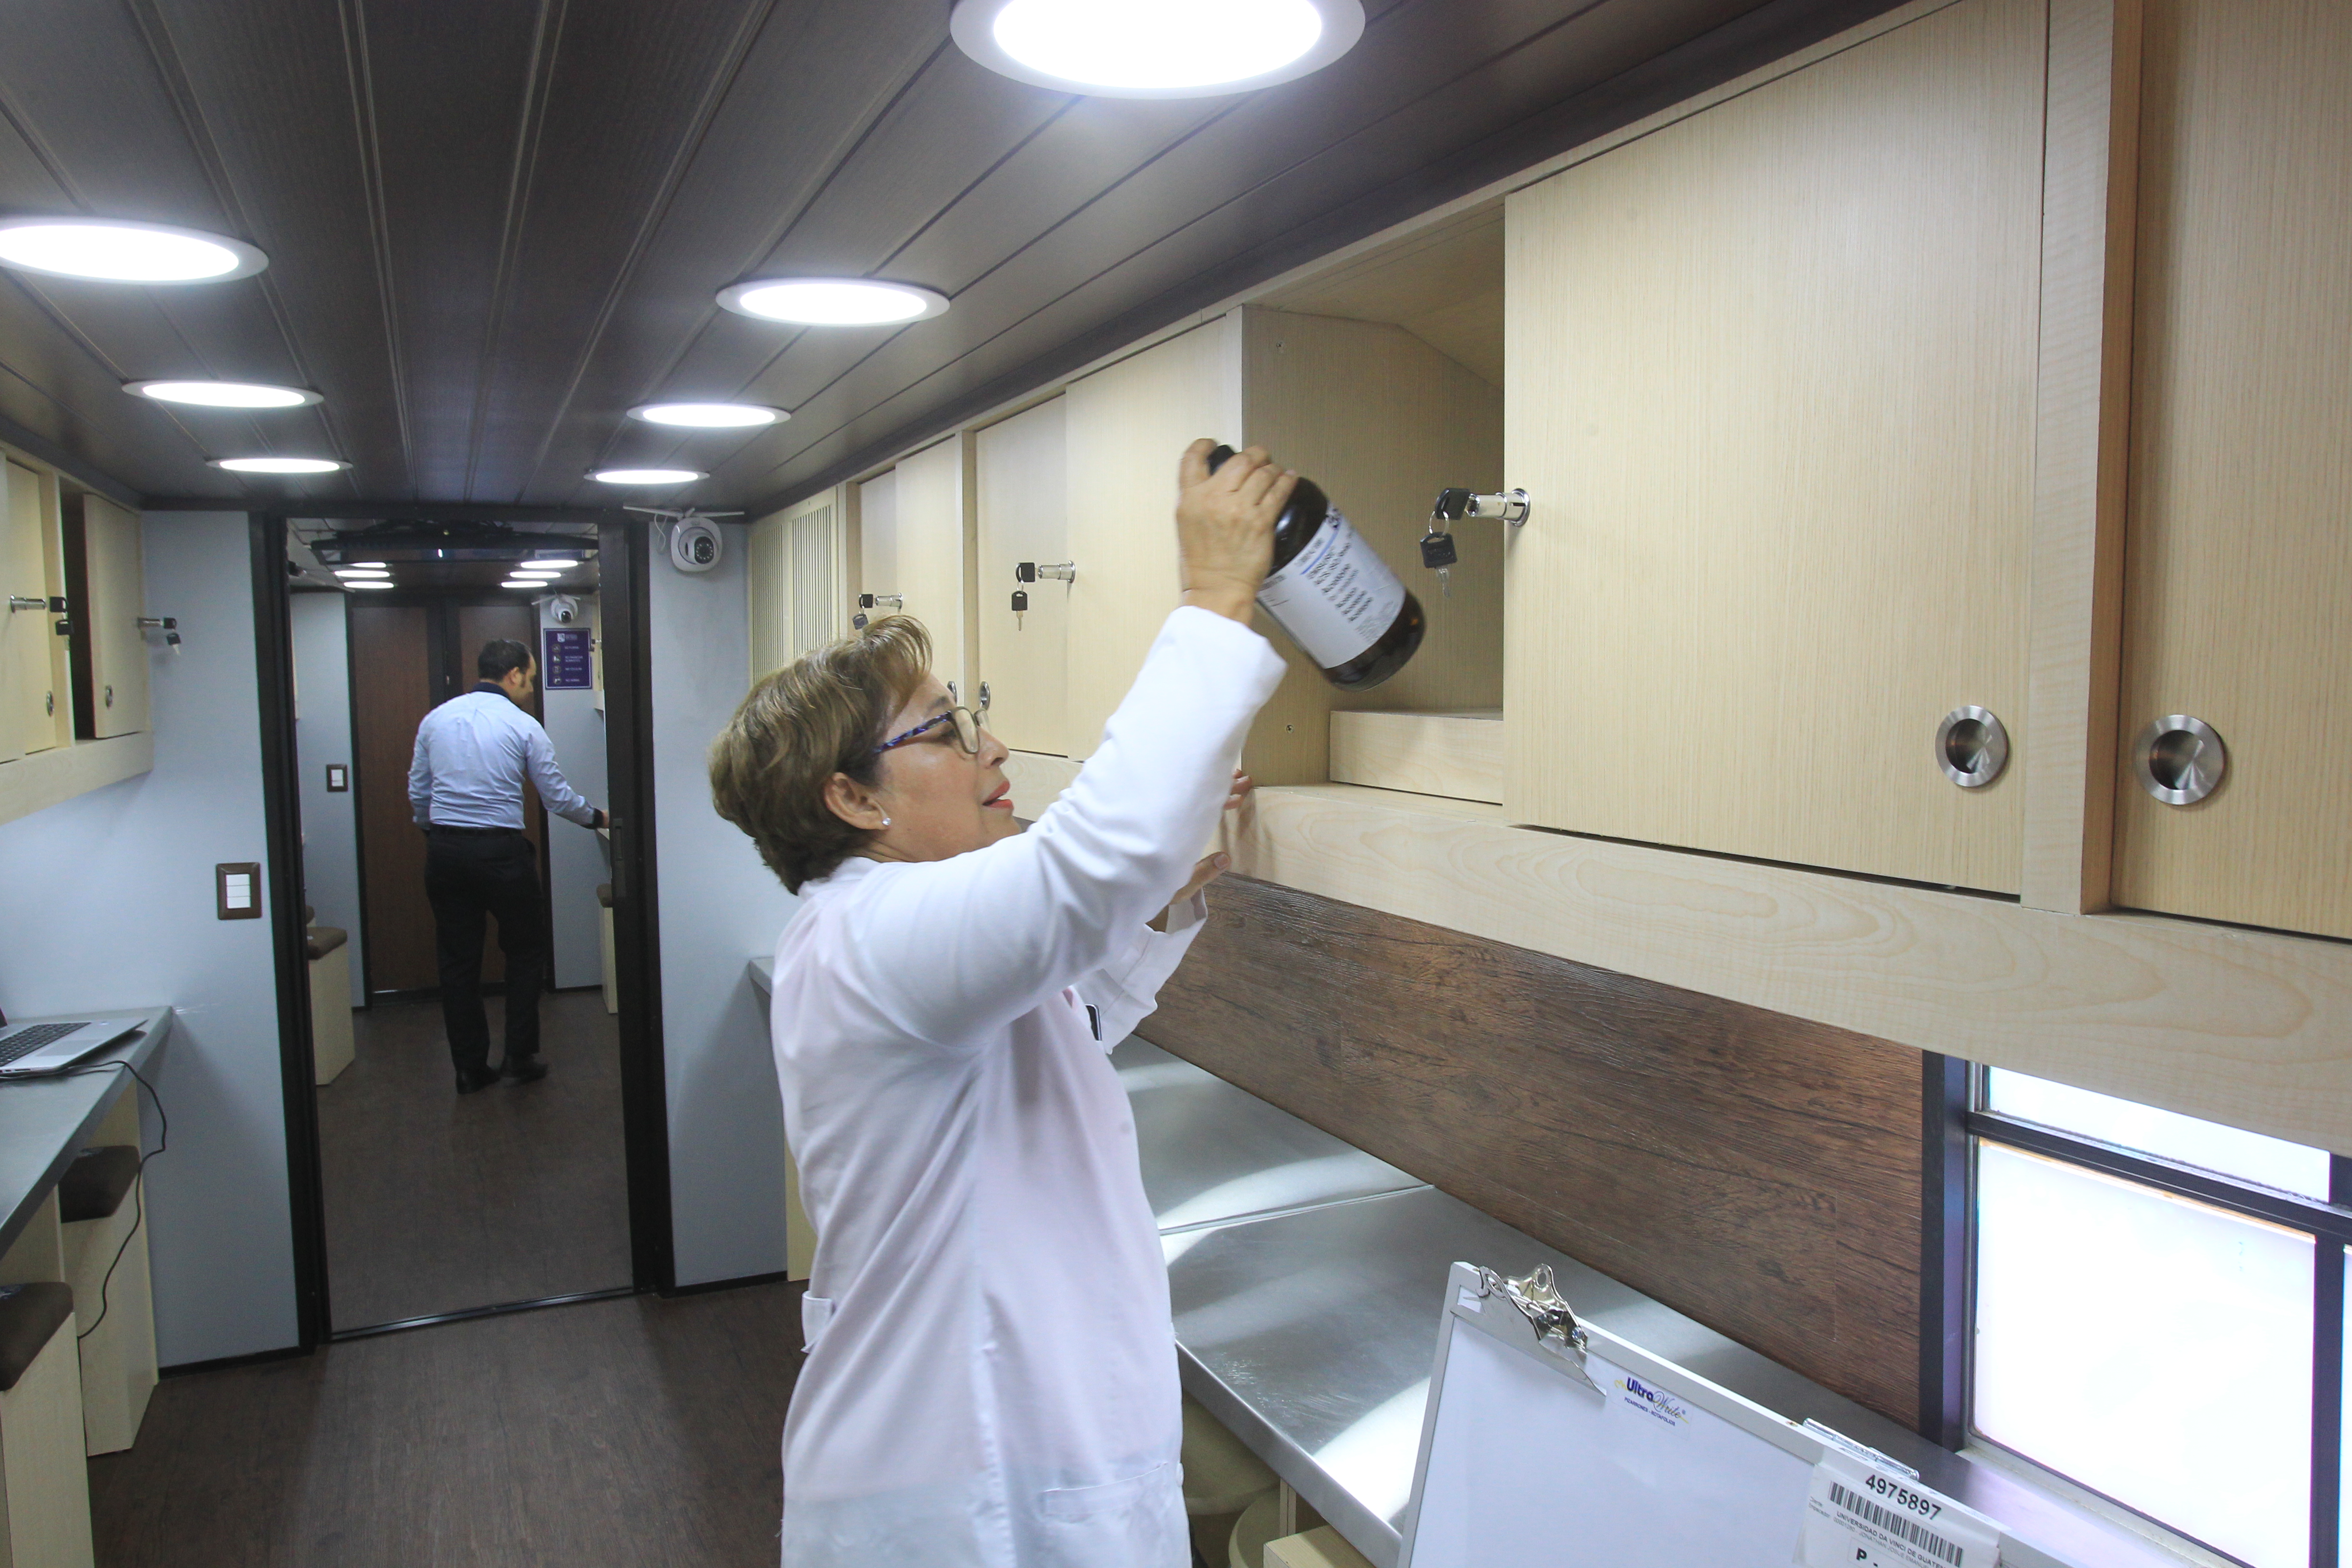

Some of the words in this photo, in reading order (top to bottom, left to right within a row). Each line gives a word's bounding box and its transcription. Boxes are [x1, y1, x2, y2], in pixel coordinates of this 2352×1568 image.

[1627, 1376, 1654, 1402] Ultra
[1866, 1474, 1941, 1520] 4975897
[1837, 1510, 1877, 1536] UNIVERSIDAD
[1879, 1532, 1887, 1542] DA
[1889, 1538, 1906, 1552] VINCI
[1907, 1547, 1917, 1557] DE
[1917, 1554, 1946, 1568] GUATE
[1856, 1547, 1867, 1561] P
